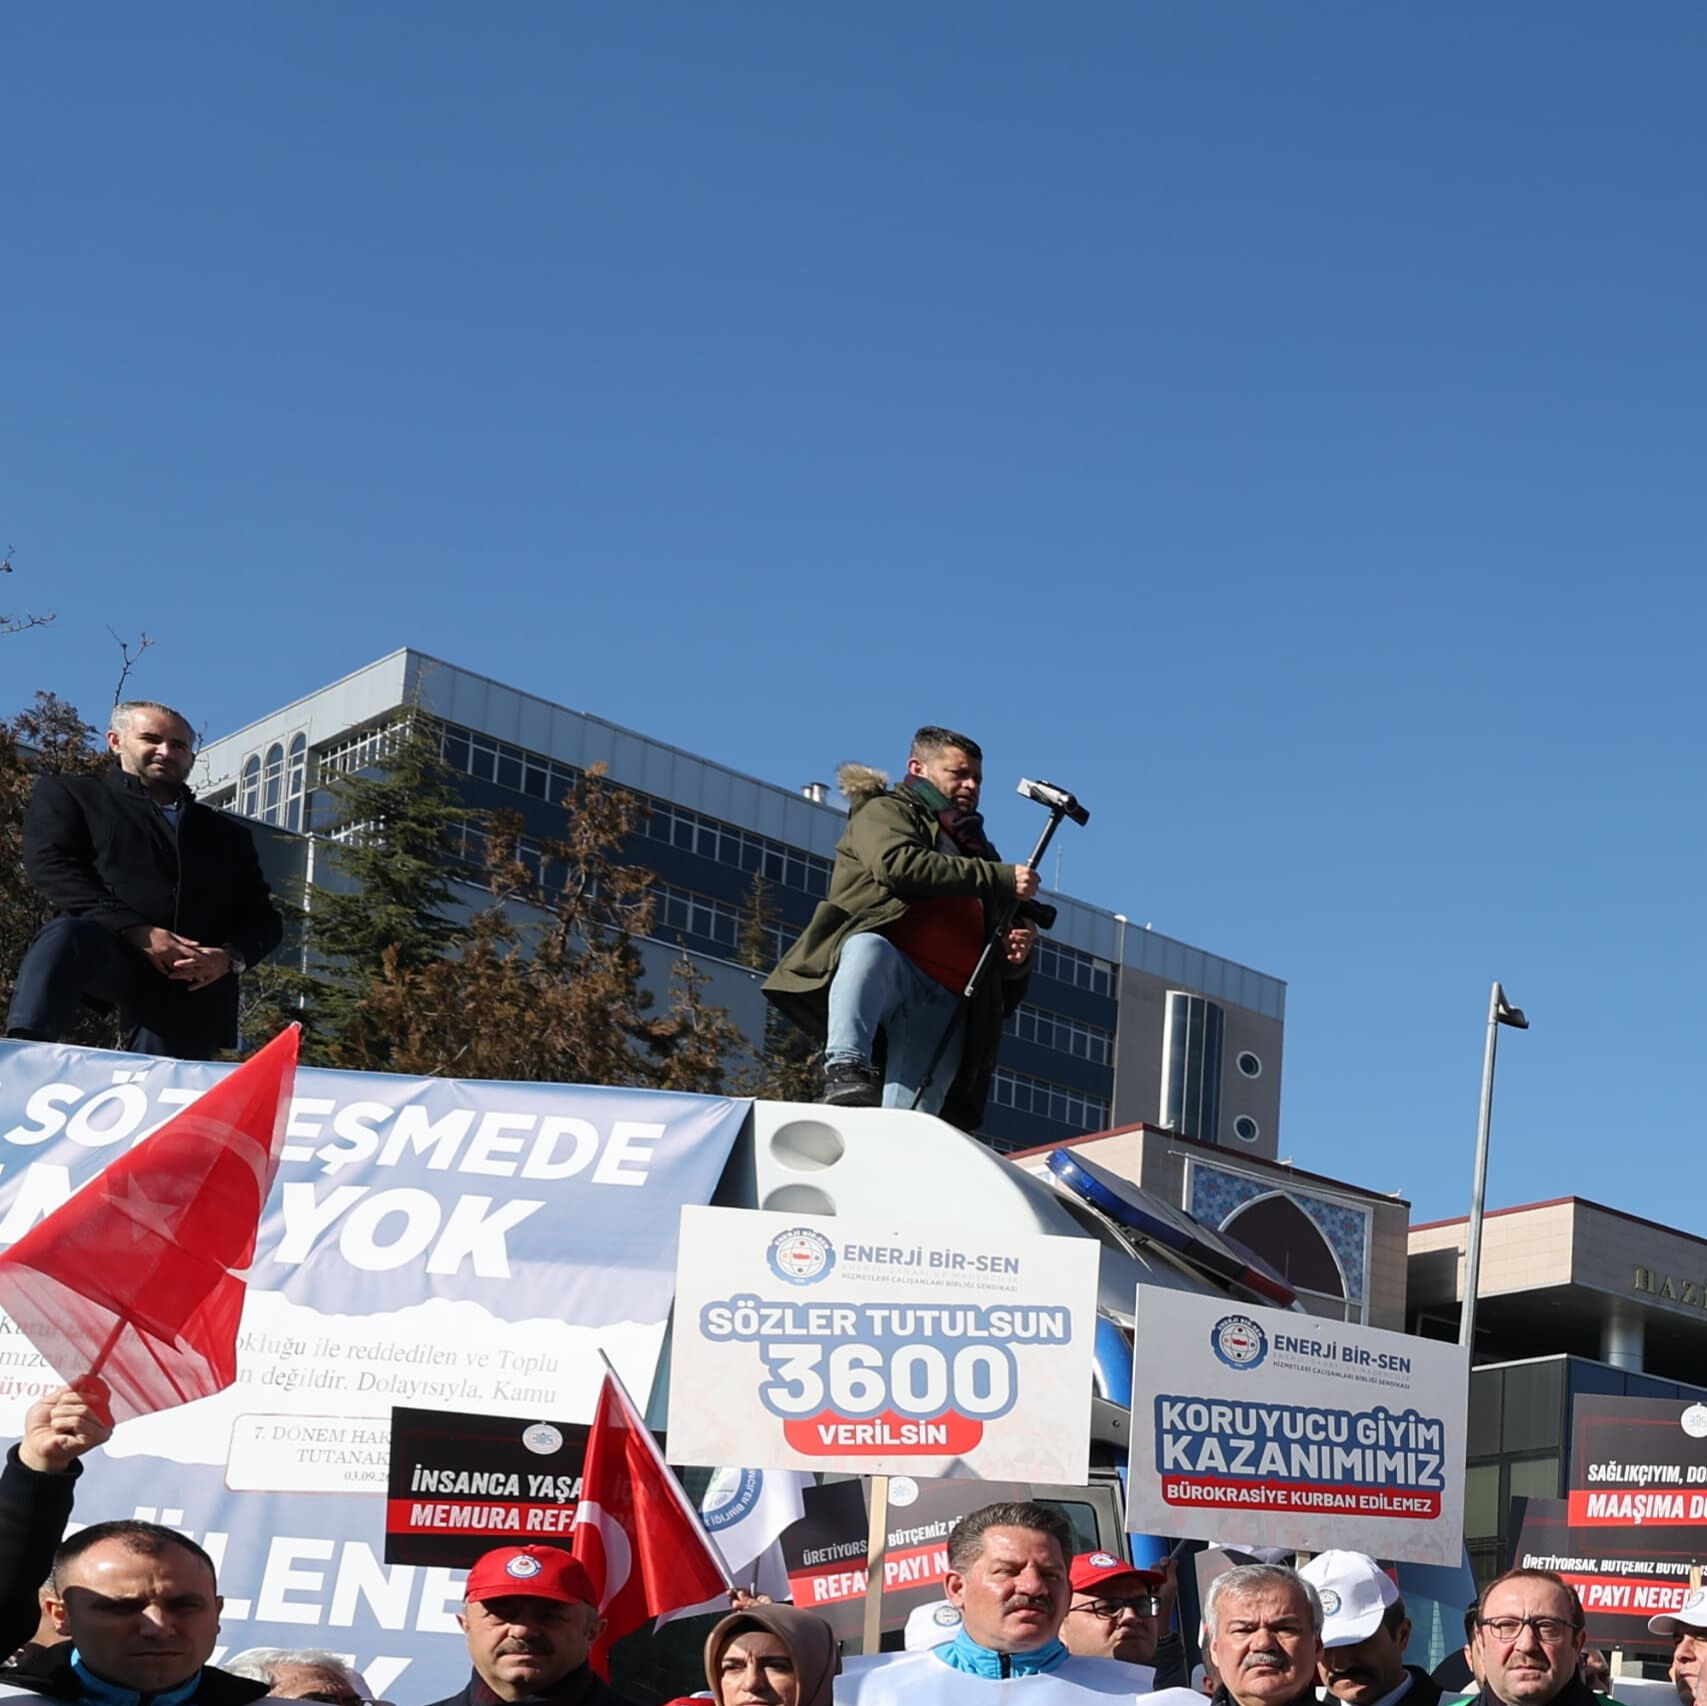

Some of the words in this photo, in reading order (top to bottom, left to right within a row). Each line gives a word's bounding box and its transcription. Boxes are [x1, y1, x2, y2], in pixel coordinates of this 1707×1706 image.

[273, 1184, 548, 1279] YOK
[843, 1244, 922, 1267] ENERJİ
[929, 1249, 1019, 1275] BİR-SEN
[707, 1300, 856, 1336] SÖZLER
[866, 1309, 1064, 1338] TUTULSUN
[346, 1341, 458, 1366] reddedilen
[498, 1349, 558, 1373] Toplu
[1274, 1334, 1337, 1360] ENERJİ
[1342, 1347, 1411, 1373] BİR-SEN
[261, 1366, 348, 1392] değildir.
[493, 1385, 556, 1404] Kamu
[767, 1343, 1009, 1414] 3600
[818, 1419, 947, 1445] VERİLSİN
[1161, 1402, 1348, 1444] KORUYUCU
[1357, 1412, 1440, 1451] GİYİM
[1163, 1434, 1440, 1487] KAZANIMIMIZ
[1588, 1462, 1683, 1487] SAĞLIKÇIYIM,
[412, 1464, 520, 1496] İNSANCA
[1167, 1481, 1287, 1505] BÜROKRASİYE
[1291, 1492, 1356, 1509] KURBAN
[1359, 1493, 1432, 1512] EDİLEMEZ
[1587, 1493, 1684, 1525] MAAŞIMA
[411, 1504, 521, 1530] MEMURA
